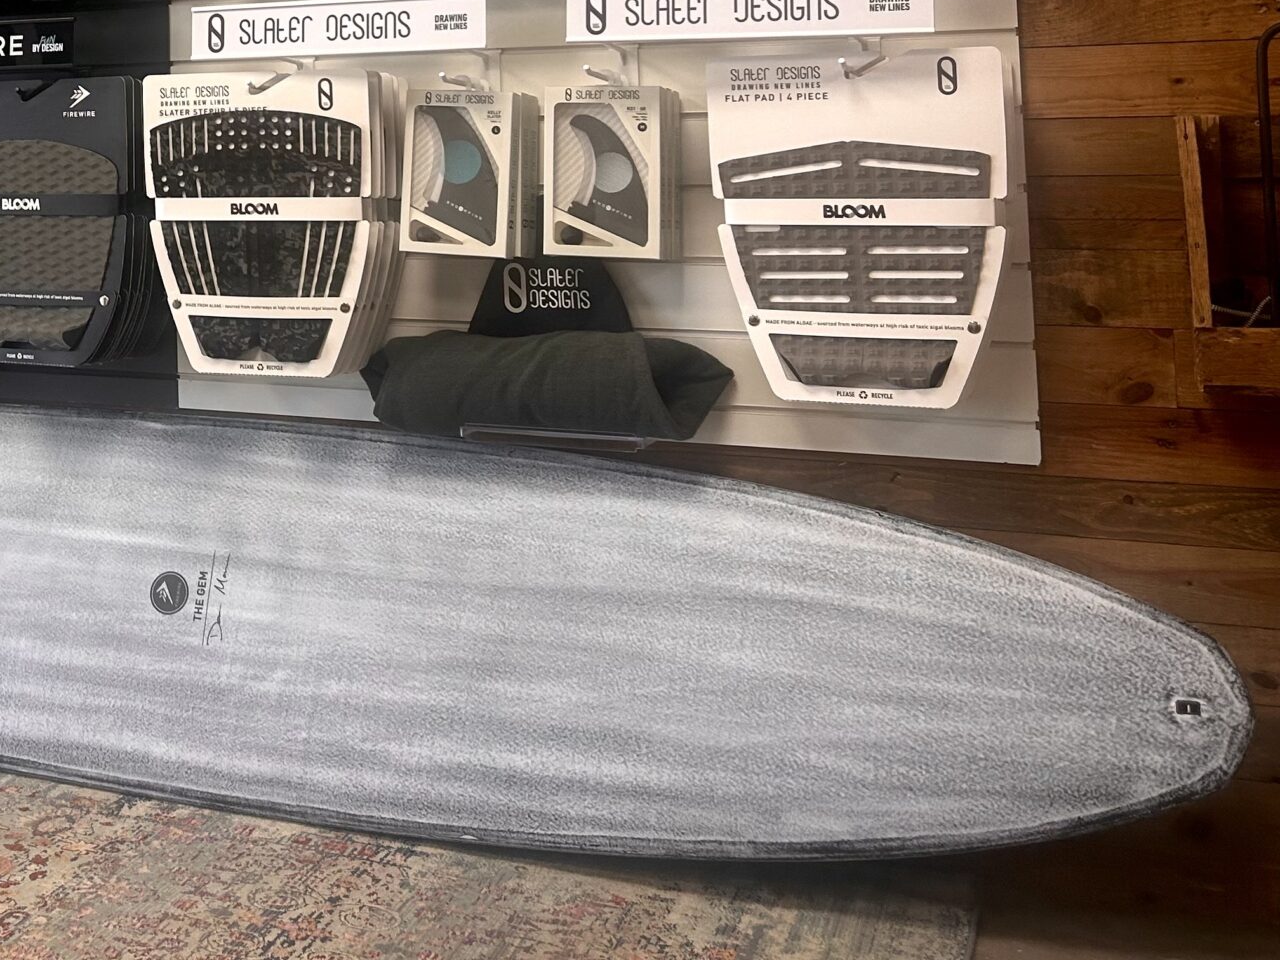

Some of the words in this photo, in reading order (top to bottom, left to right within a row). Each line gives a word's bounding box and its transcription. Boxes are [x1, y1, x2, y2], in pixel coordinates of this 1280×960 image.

[869, 2, 887, 12] NEW
[887, 1, 911, 12] LINES
[434, 13, 468, 23] DRAWING
[326, 10, 411, 41] DESIGNS
[434, 22, 449, 31] NEW
[449, 21, 468, 30] LINES
[32, 43, 41, 53] BY
[41, 42, 64, 53] DESIGN
[776, 65, 821, 81] DESIGNS
[731, 83, 770, 91] DRAWING
[774, 82, 791, 90] NEW
[795, 81, 821, 89] LINES
[724, 94, 750, 103] FLAT
[754, 93, 775, 102] PAD
[786, 93, 792, 101] 4
[797, 92, 829, 100] PIECE
[62, 110, 96, 118] FIREWIRE
[159, 108, 190, 117] SLATER
[1, 198, 41, 211] BLOOM
[230, 203, 279, 216] BLOOM
[822, 204, 886, 219] BLOOM
[529, 289, 591, 309] DESIGNS
[836, 390, 855, 398] PLEASE
[871, 392, 893, 400] RECYCLE
[196, 571, 209, 596] GEM
[192, 599, 204, 622] THE
